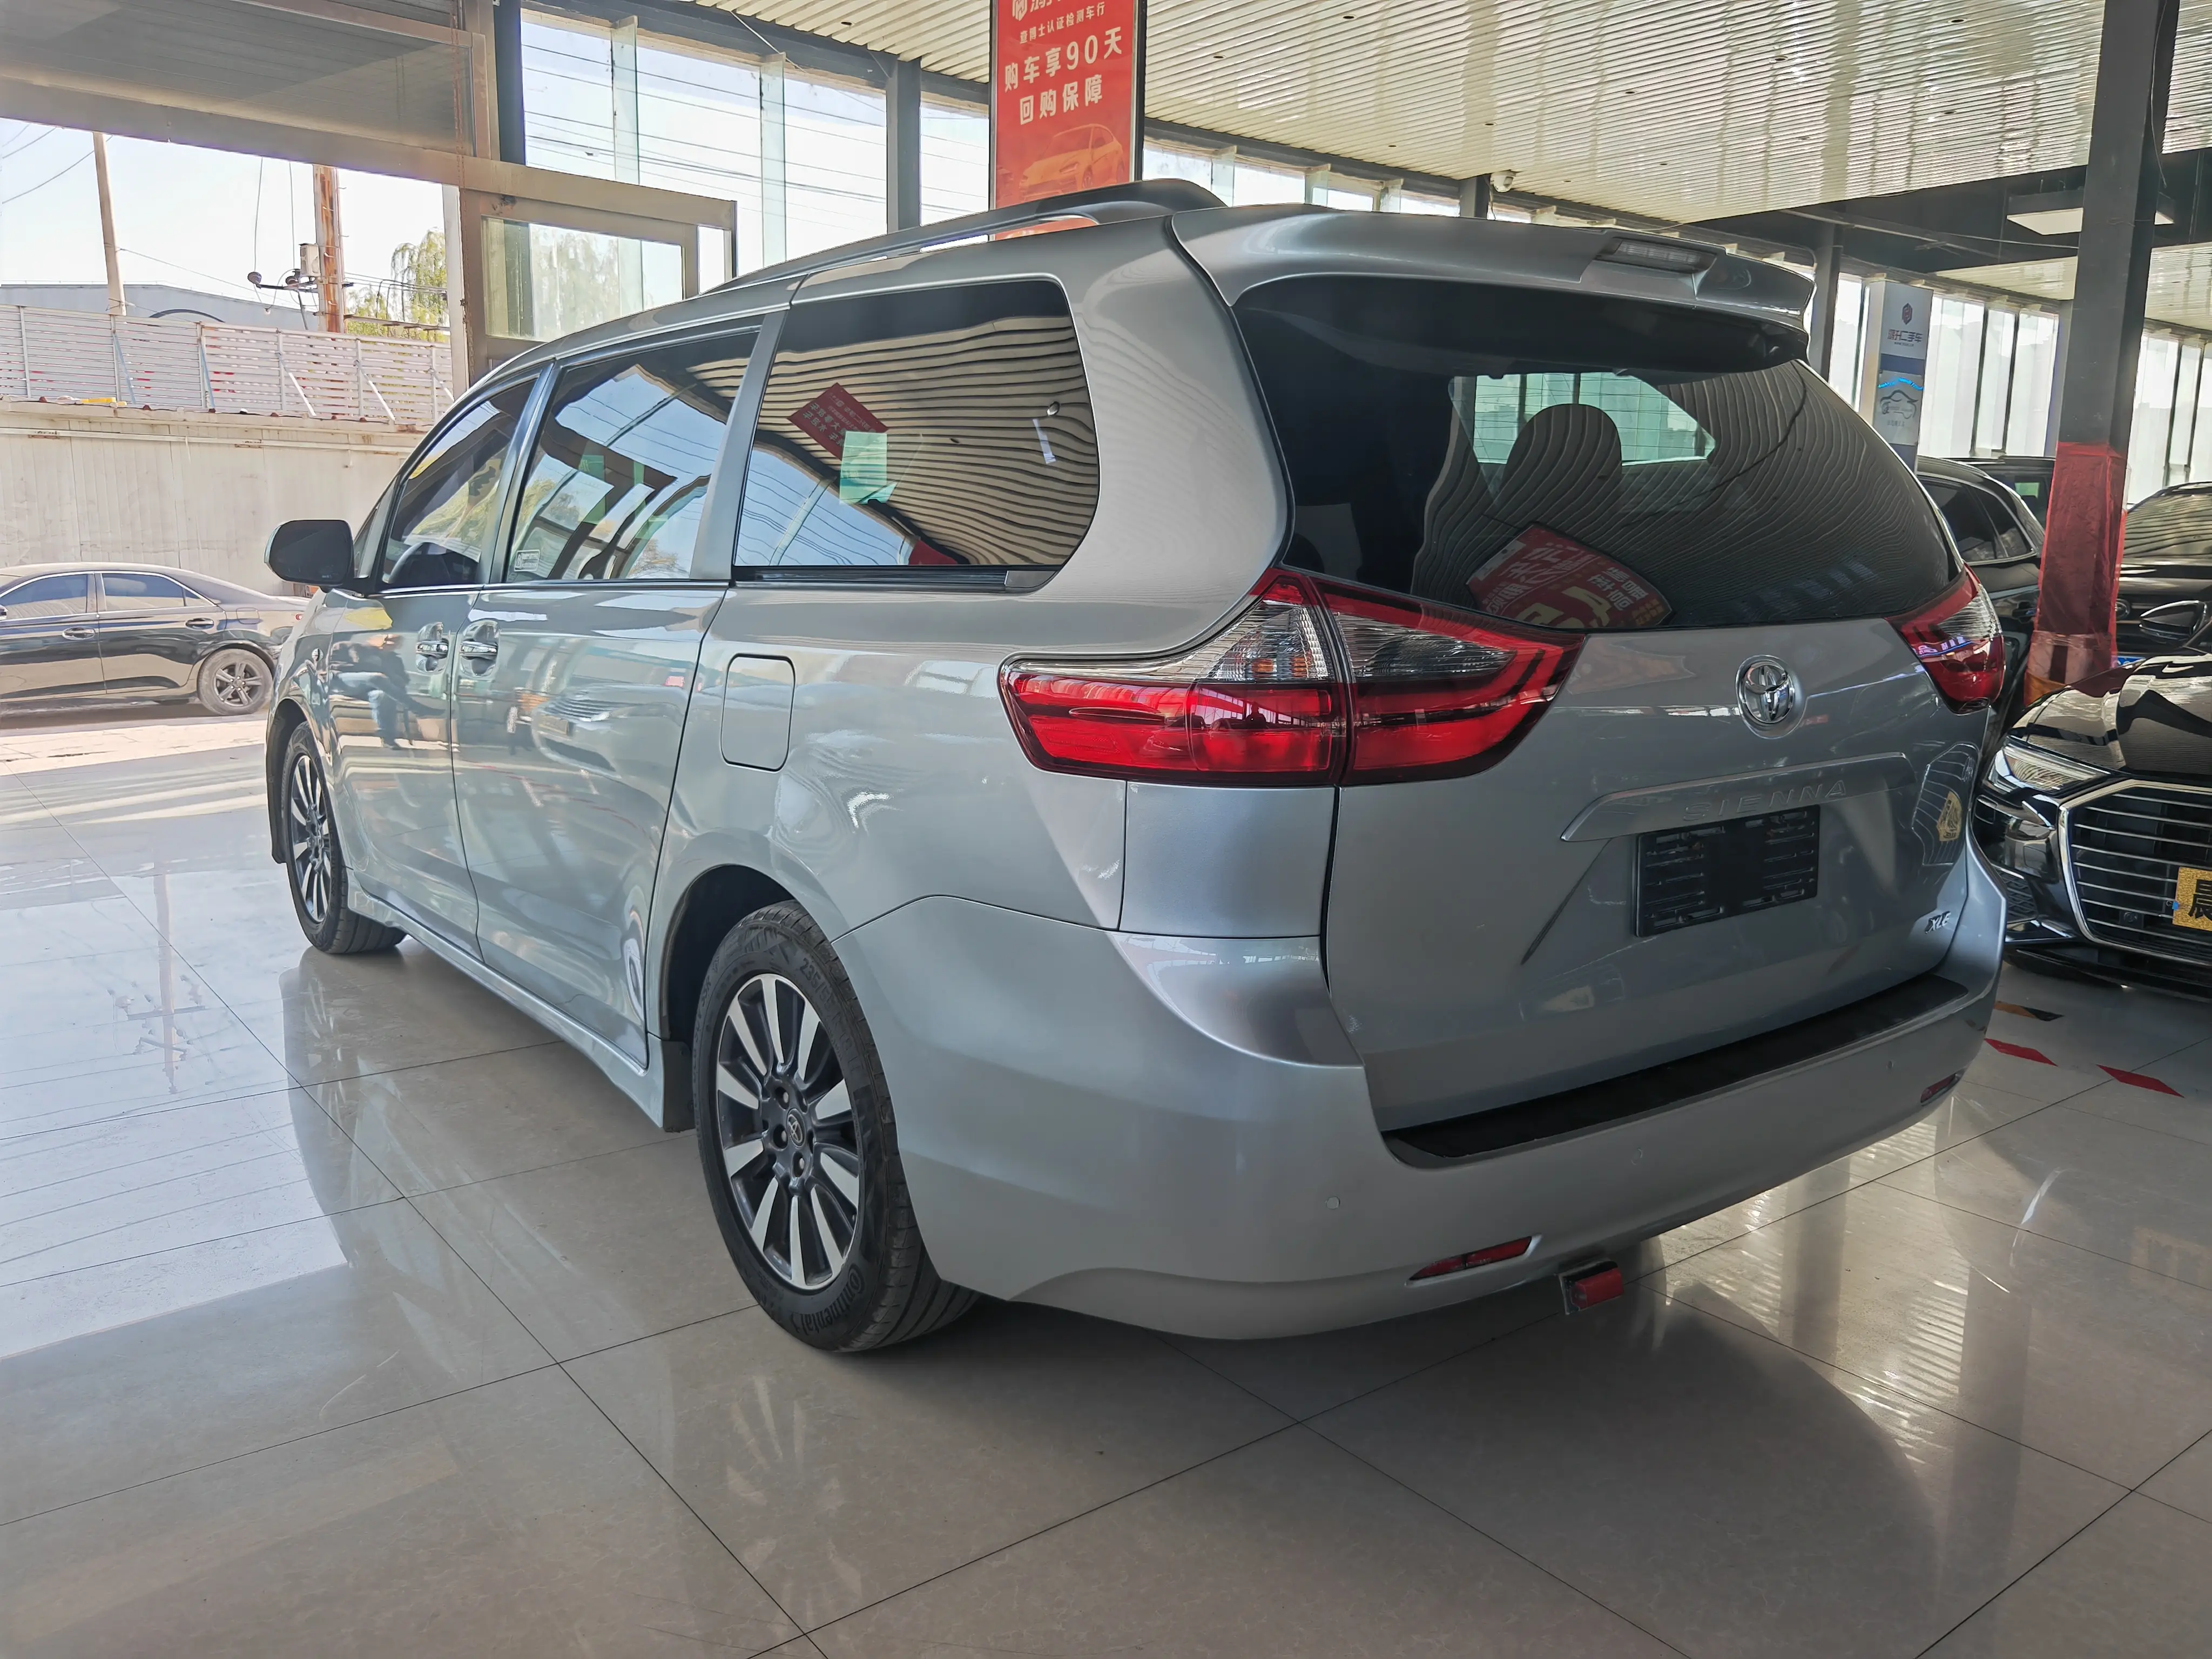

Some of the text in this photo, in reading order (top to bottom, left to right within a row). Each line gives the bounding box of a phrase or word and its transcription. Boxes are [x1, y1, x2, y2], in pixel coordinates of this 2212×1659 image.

[1004, 26, 1122, 93] 购车享90天
[1020, 75, 1103, 125] 回购保障
[1683, 780, 1846, 821] SIENNA
[1925, 911, 1951, 934] XLE
[800, 1262, 865, 1336] Continental
